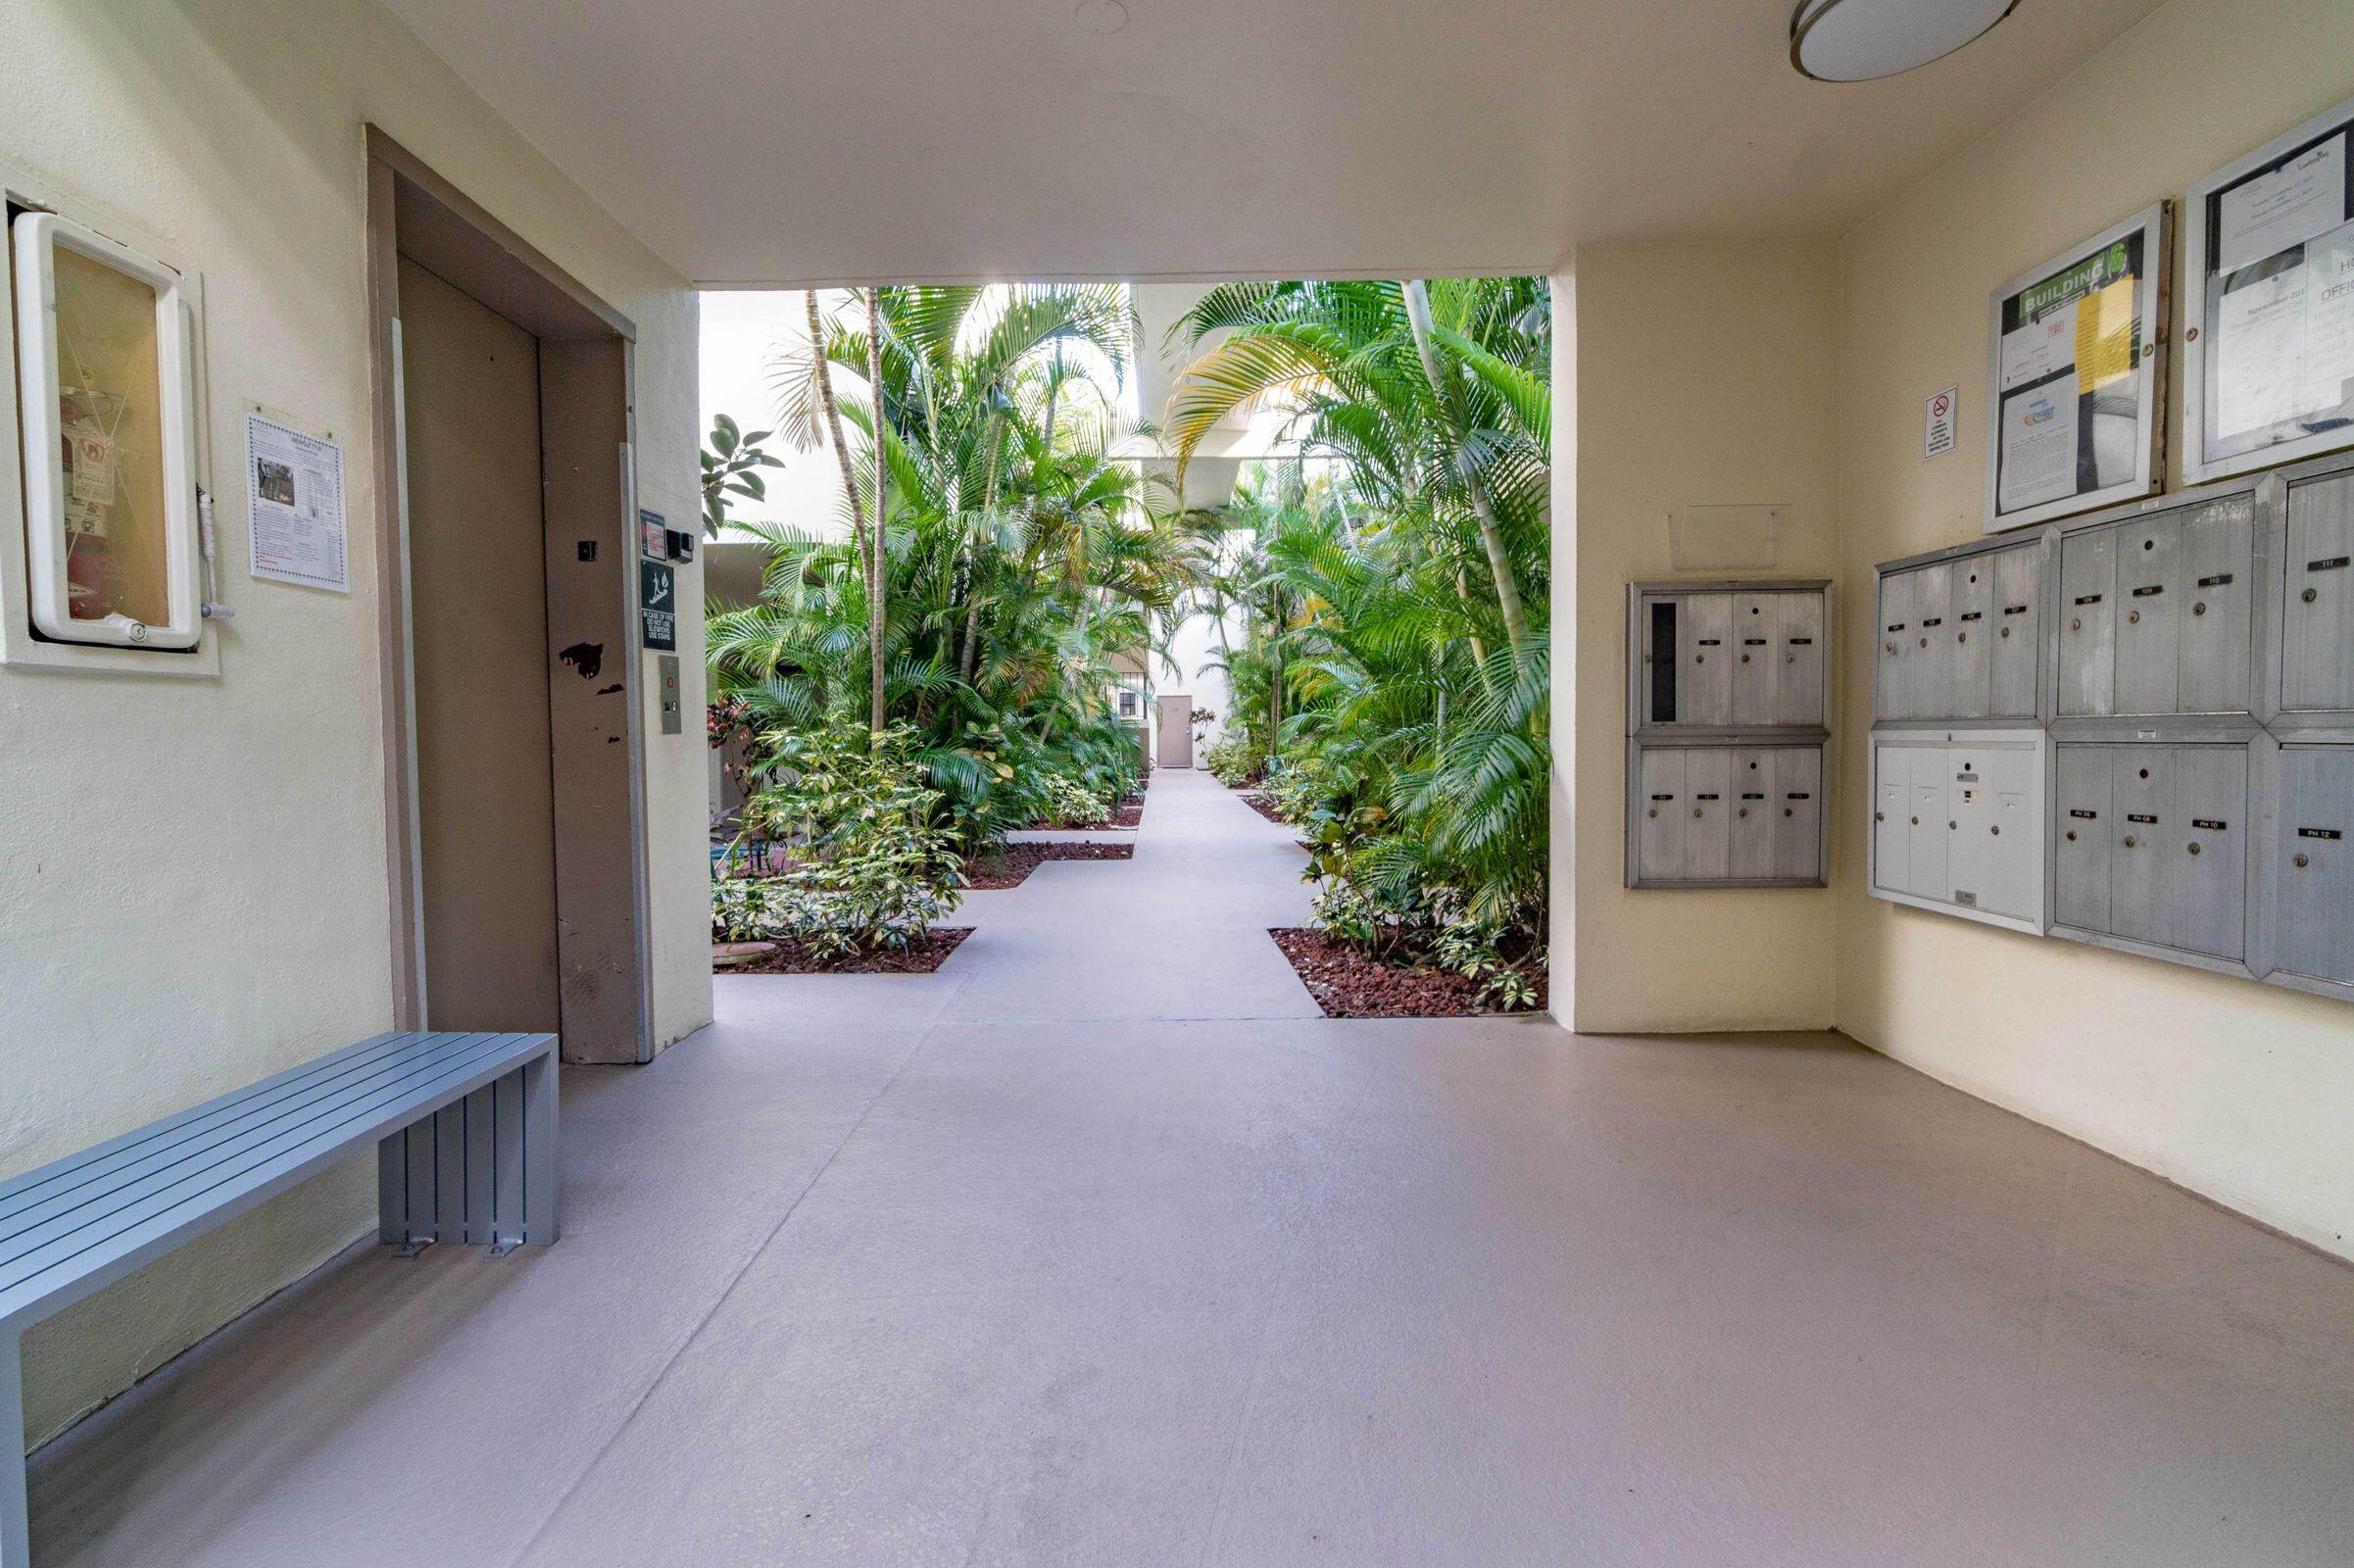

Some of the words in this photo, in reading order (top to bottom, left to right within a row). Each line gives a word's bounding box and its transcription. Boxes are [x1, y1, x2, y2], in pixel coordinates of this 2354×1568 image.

[2025, 263, 2104, 313] BUILDING
[2109, 241, 2126, 273] 6
[2321, 280, 2354, 301] OFFI
[2247, 295, 2288, 316] November
[2322, 560, 2333, 568] 111
